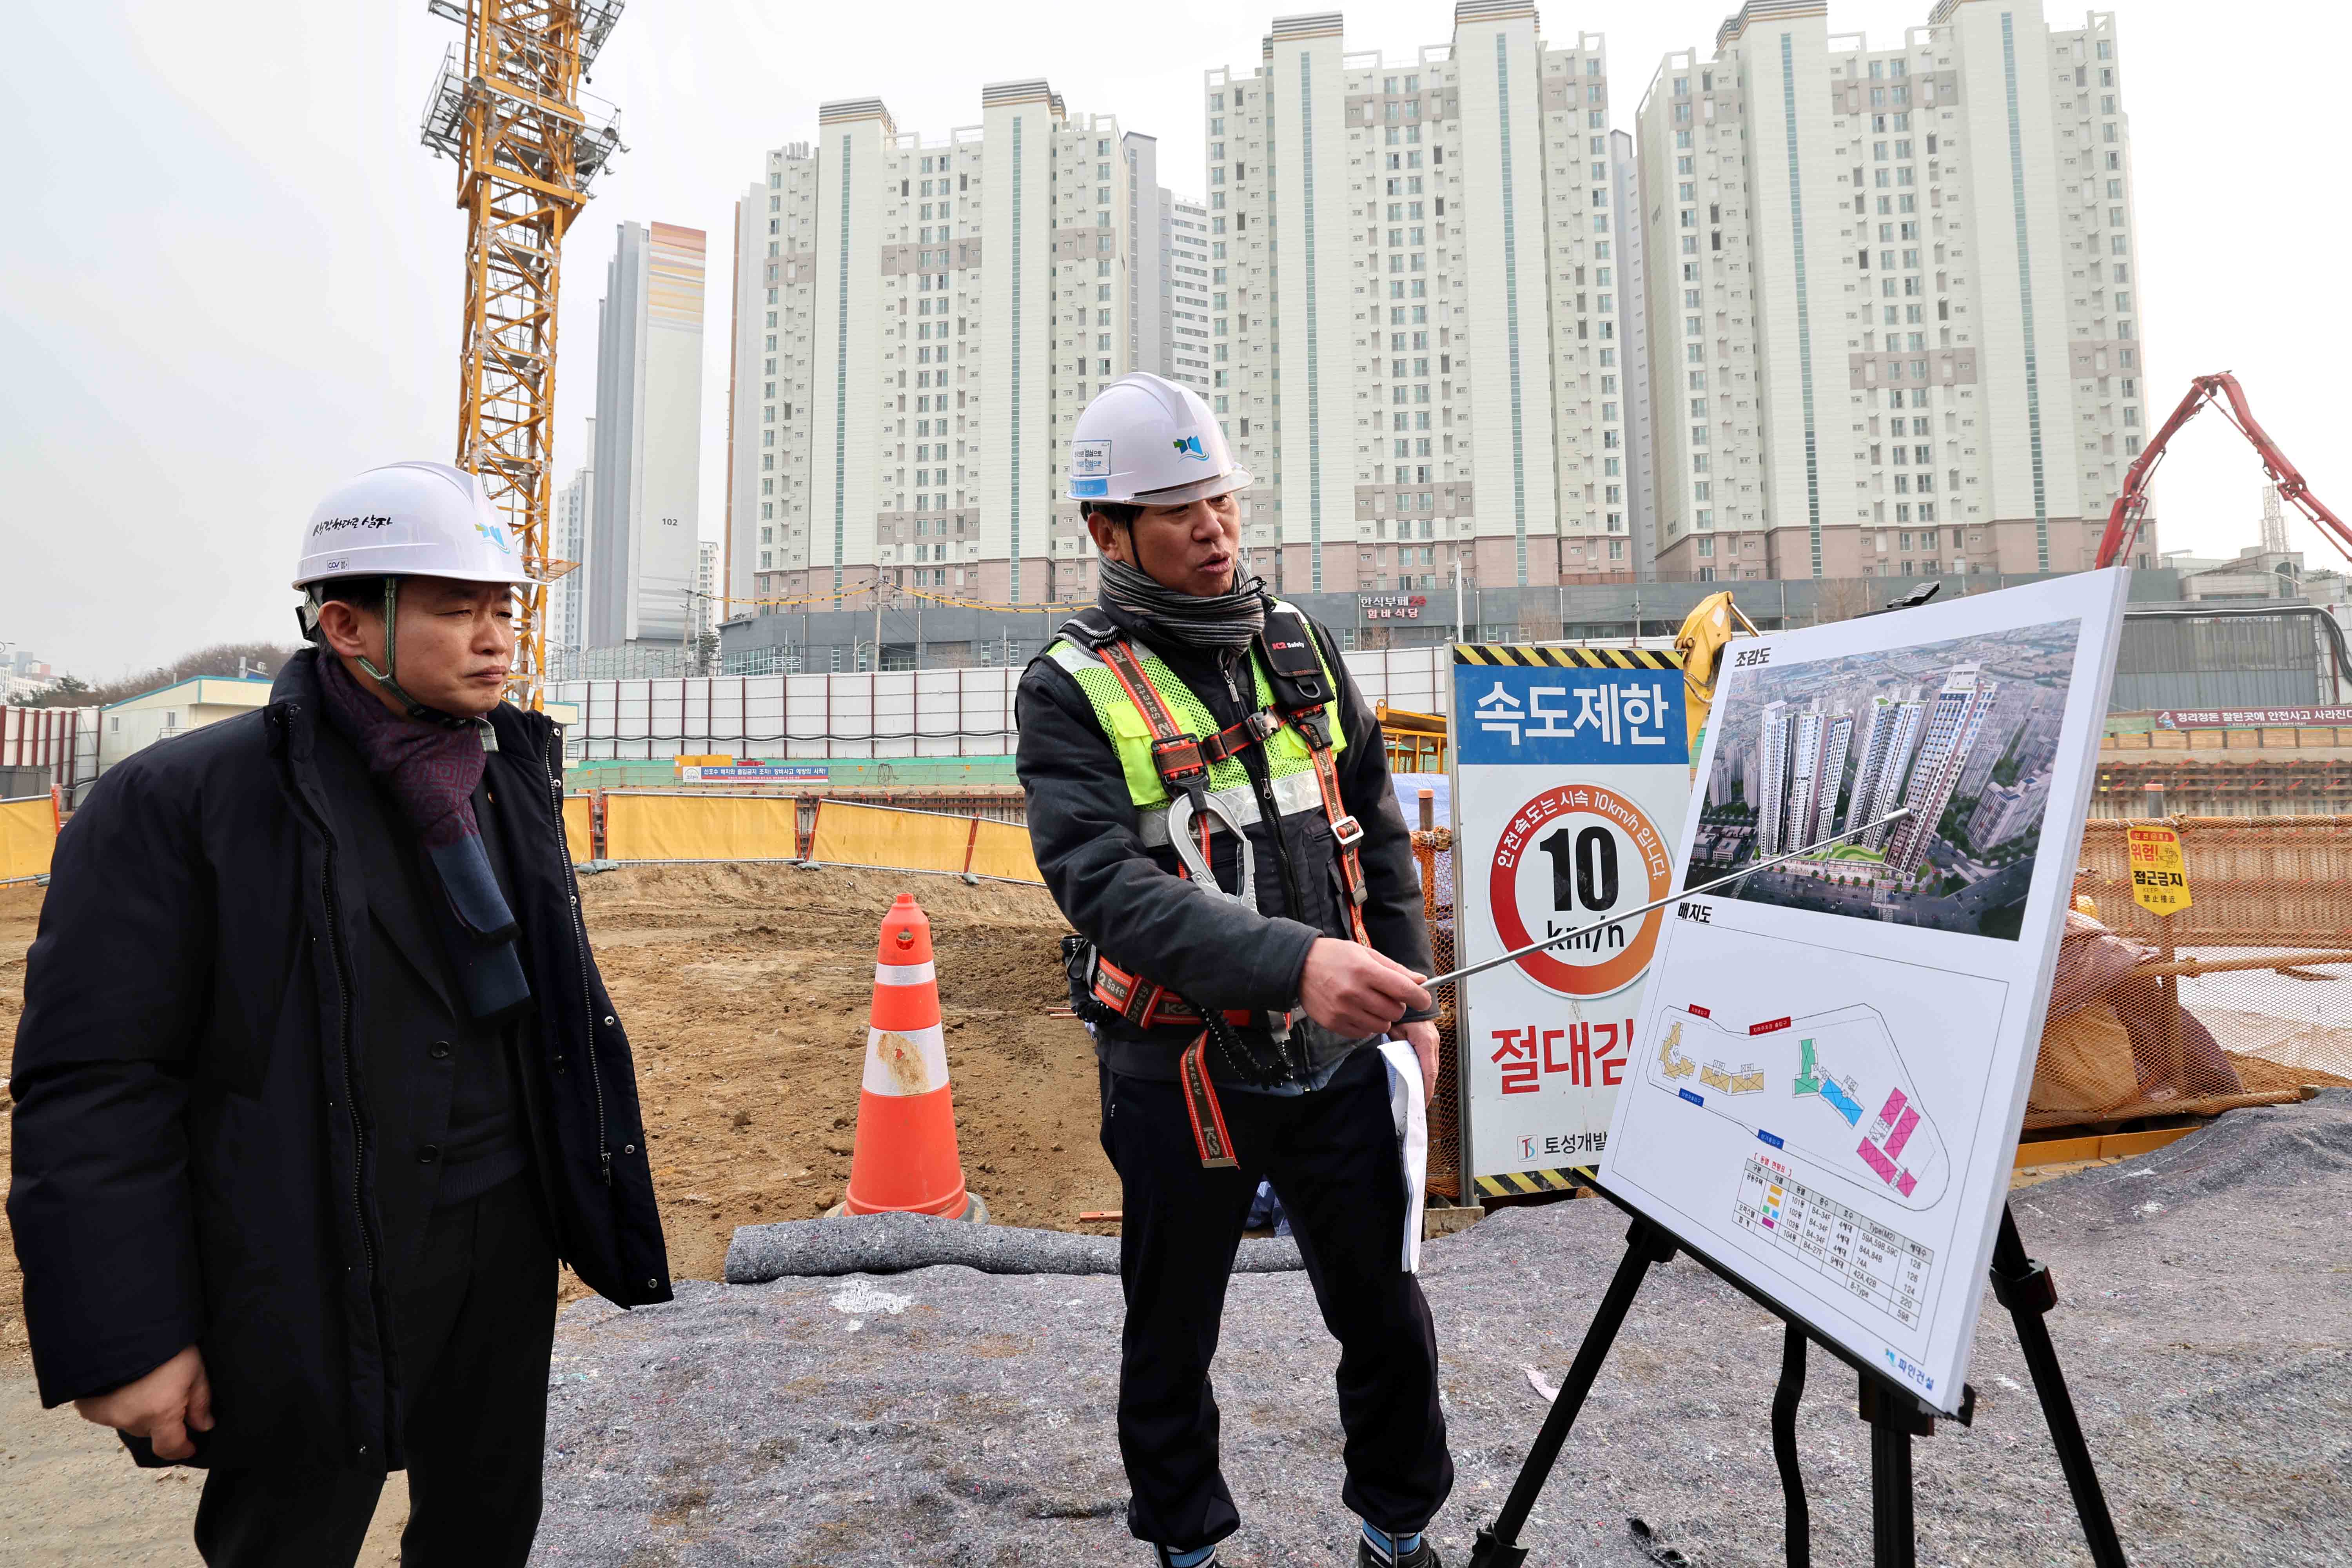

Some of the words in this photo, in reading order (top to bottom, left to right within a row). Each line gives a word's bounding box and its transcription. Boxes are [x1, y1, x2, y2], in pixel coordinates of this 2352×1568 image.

[312, 517, 359, 537] 생각한대로
[361, 514, 393, 528] 살자
[1360, 596, 1408, 608] 한식부페
[1367, 608, 1418, 619] 함바식당
[1272, 642, 1287, 650] K2
[1734, 647, 1771, 668] 조감도
[1135, 684, 1161, 720] Safety
[1474, 681, 1669, 746] 속도제한
[2176, 712, 2219, 722] 정리정돈
[2222, 711, 2265, 722] 잘된곳에
[2268, 710, 2311, 721] 안전사고
[1497, 798, 1557, 868] 안전속도는
[1561, 790, 1588, 807] 시속
[1594, 791, 1639, 831] 10km/h
[1637, 828, 1666, 880] 입니다.
[2131, 843, 2158, 861] 위험!
[1539, 826, 1619, 911] 10
[2133, 871, 2183, 887] 접근금지
[1678, 902, 1713, 924] 배치도
[2143, 895, 2176, 903] 禁止接近
[1098, 969, 1106, 987] 2
[1107, 978, 1127, 998] Safe
[1188, 1049, 1201, 1095] Safety
[1203, 1126, 1220, 1156] K2
[1746, 1172, 1763, 1187] 공동주택
[1791, 1196, 1805, 1209] 101동
[1811, 1206, 1831, 1221] B4-34F
[1839, 1221, 1853, 1234] 4세대
[1862, 1232, 1899, 1258] 59A,59B,59C
[1753, 1163, 1762, 1174] 구분
[1869, 1222, 1895, 1242] Type(M2)
[1909, 1243, 1927, 1258] 세대수
[1789, 1207, 1802, 1220] 102동
[1809, 1218, 1829, 1232] B4-34F
[1836, 1233, 1850, 1245] 4세대
[1859, 1245, 1883, 1263] 84A,84B
[1738, 1204, 1755, 1219] 오피스텔
[1784, 1230, 1797, 1242] 104동
[1803, 1241, 1823, 1256] B4-27F
[1830, 1256, 1844, 1269] 9세대
[1853, 1269, 1877, 1288] 42A,42B
[1900, 1296, 1912, 1309] 220
[1786, 1218, 1799, 1231] 103동
[1806, 1229, 1826, 1244] B4-34F
[1833, 1245, 1847, 1257] 4세대
[1856, 1256, 1867, 1269] 74A
[1904, 1284, 1915, 1295] 124
[1898, 1357, 1934, 1391] 파인건설
